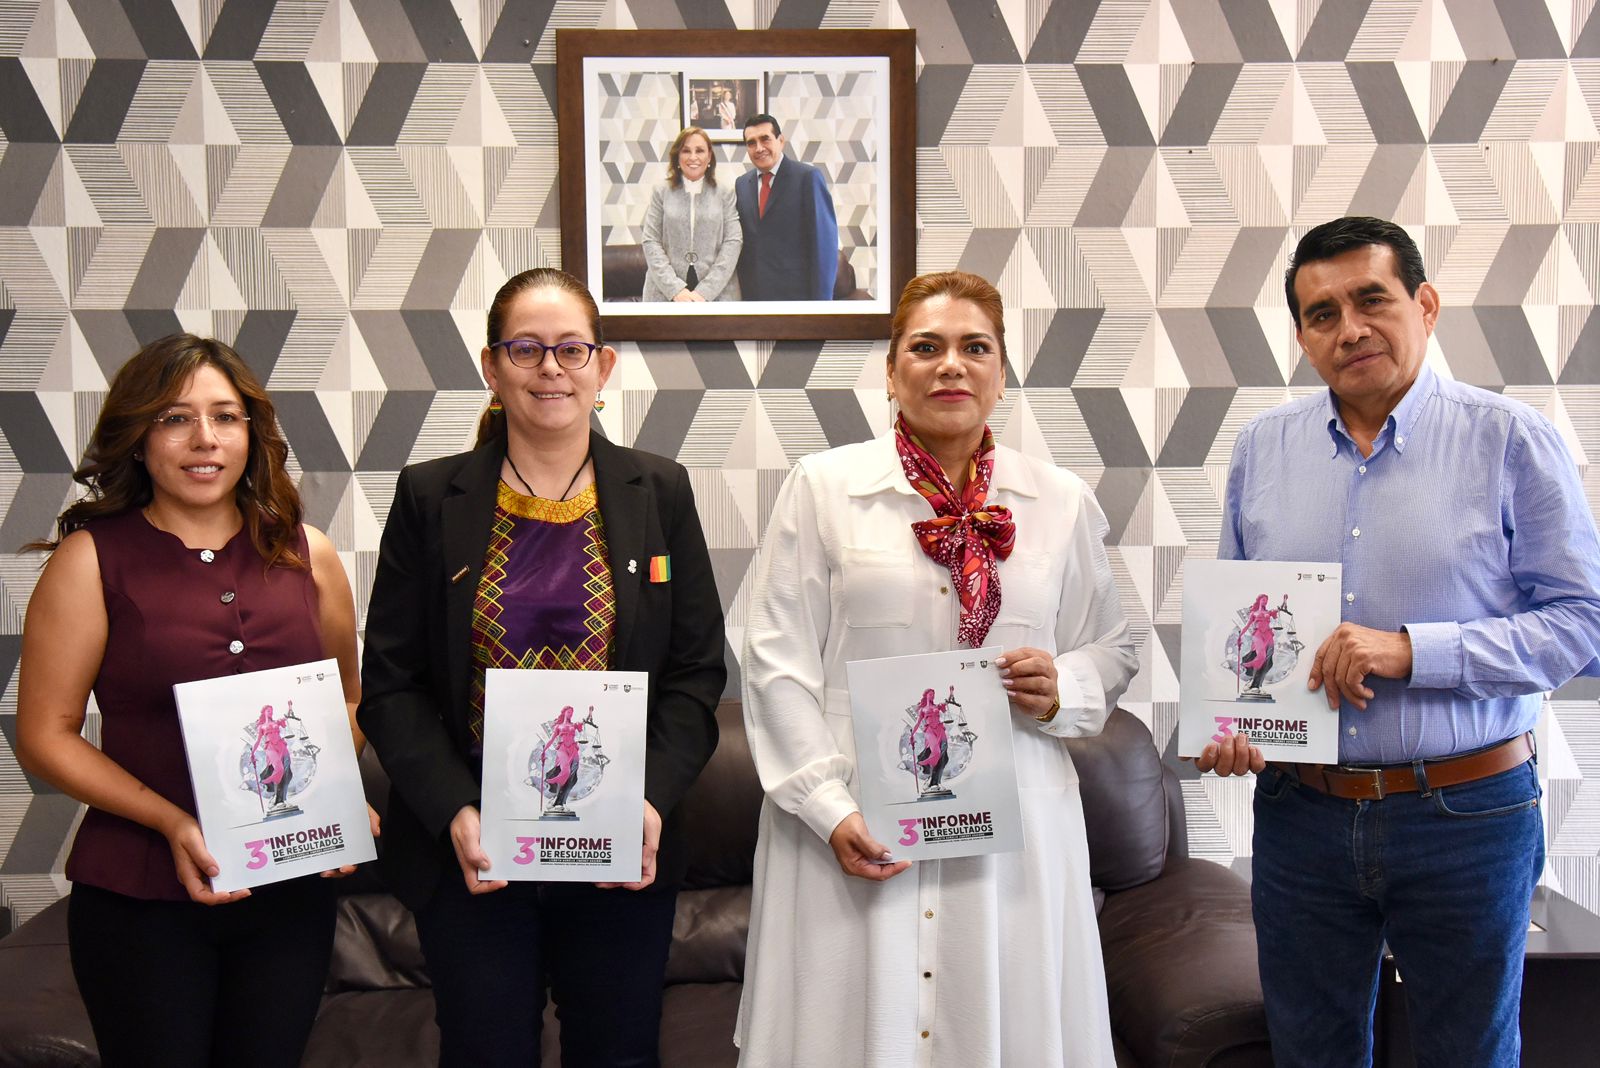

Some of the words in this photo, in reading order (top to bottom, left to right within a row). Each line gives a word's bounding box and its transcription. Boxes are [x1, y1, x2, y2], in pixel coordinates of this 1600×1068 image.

[1238, 717, 1308, 732] INFORME
[1251, 730, 1308, 740] RESULTADOS
[922, 811, 992, 830] INFORME
[269, 823, 342, 850] INFORME
[923, 829, 936, 838] DE
[937, 824, 993, 836] RESULTADOS
[272, 849, 285, 858] DE
[286, 836, 344, 855] RESULTADOS
[540, 837, 612, 850] INFORME
[540, 850, 553, 858] DE
[554, 850, 612, 859] RESULTADOS
